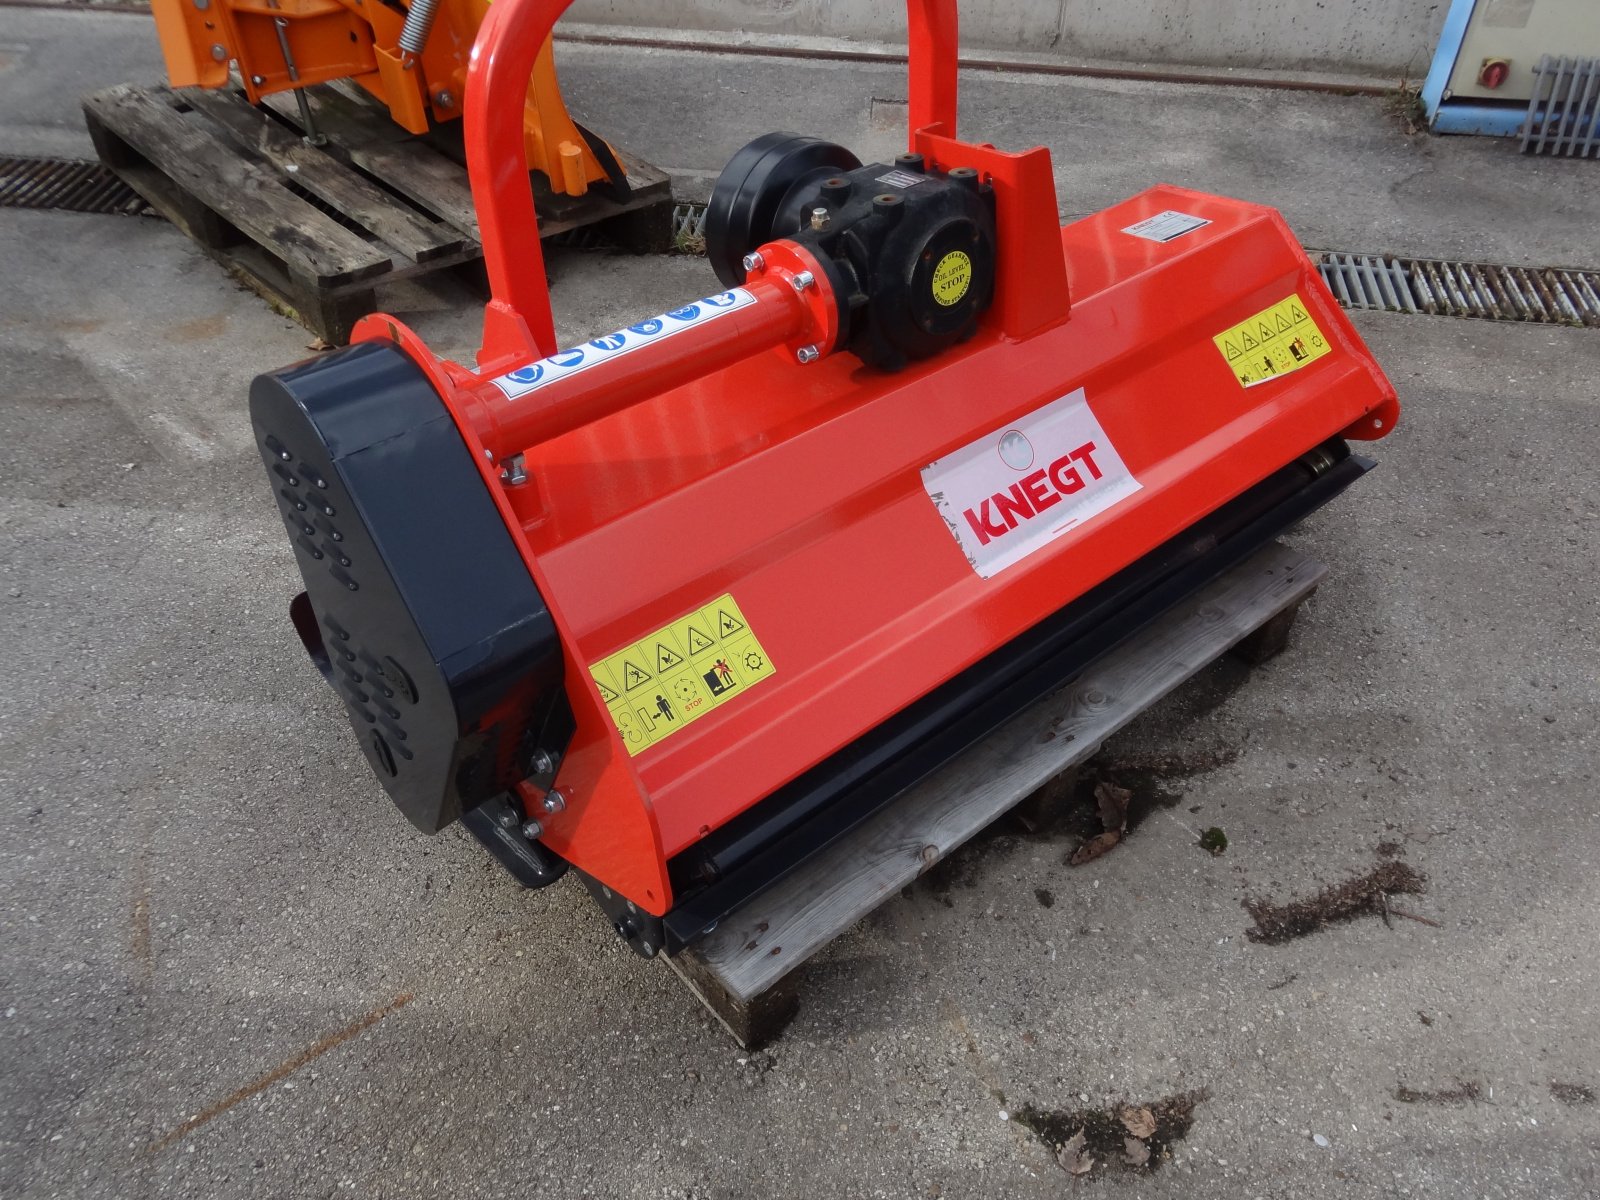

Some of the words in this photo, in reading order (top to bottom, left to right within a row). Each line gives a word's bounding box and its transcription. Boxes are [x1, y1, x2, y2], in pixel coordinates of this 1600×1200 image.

[933, 260, 947, 284] CHECK
[947, 252, 969, 266] GEARBOX
[948, 263, 965, 276] LEVEL
[940, 273, 965, 293] STOP
[963, 441, 1103, 546] KNEGT
[685, 697, 703, 712] STOP
